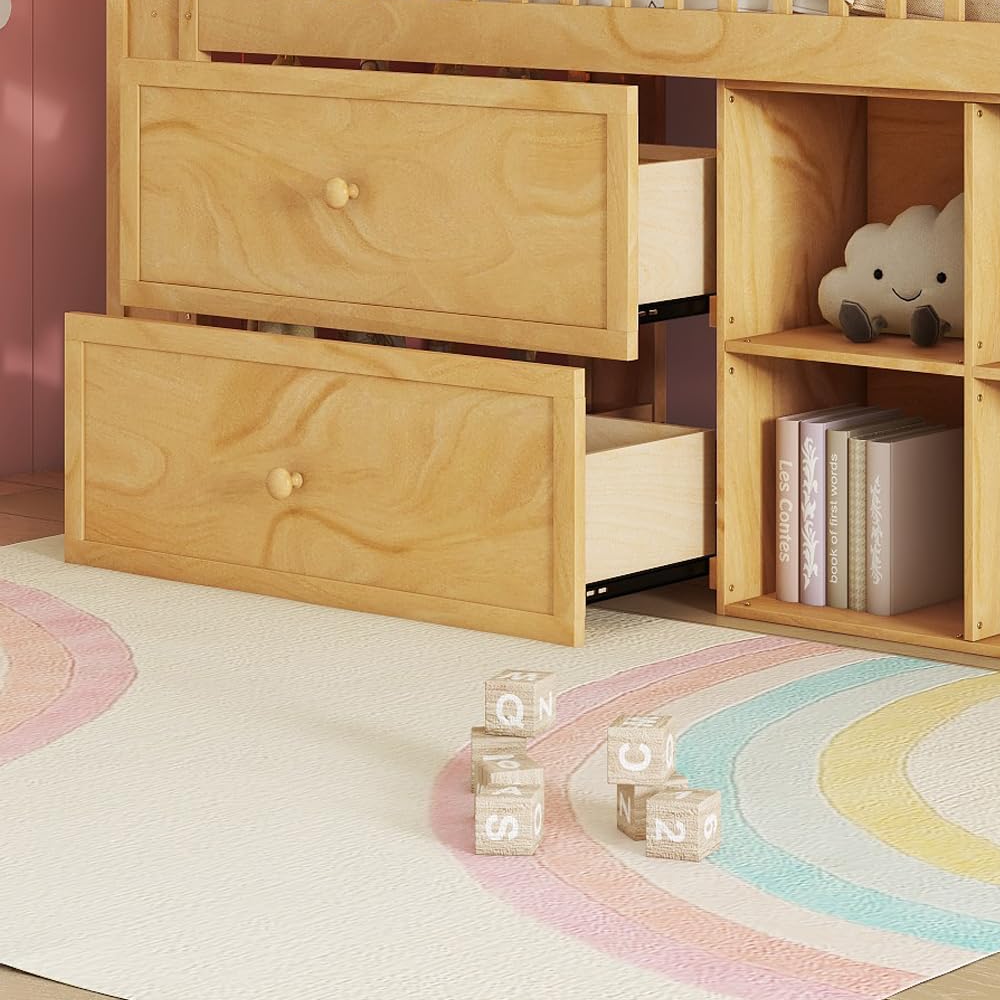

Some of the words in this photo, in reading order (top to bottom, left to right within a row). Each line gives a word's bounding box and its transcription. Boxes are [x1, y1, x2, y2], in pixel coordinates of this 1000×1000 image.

[778, 460, 793, 492] Les
[830, 453, 838, 498] words
[830, 501, 838, 525] first
[778, 499, 793, 563] Contes
[830, 527, 838, 545] of
[830, 548, 838, 584] book
[495, 693, 524, 729] Q
[619, 743, 651, 772] C
[485, 814, 519, 841] S
